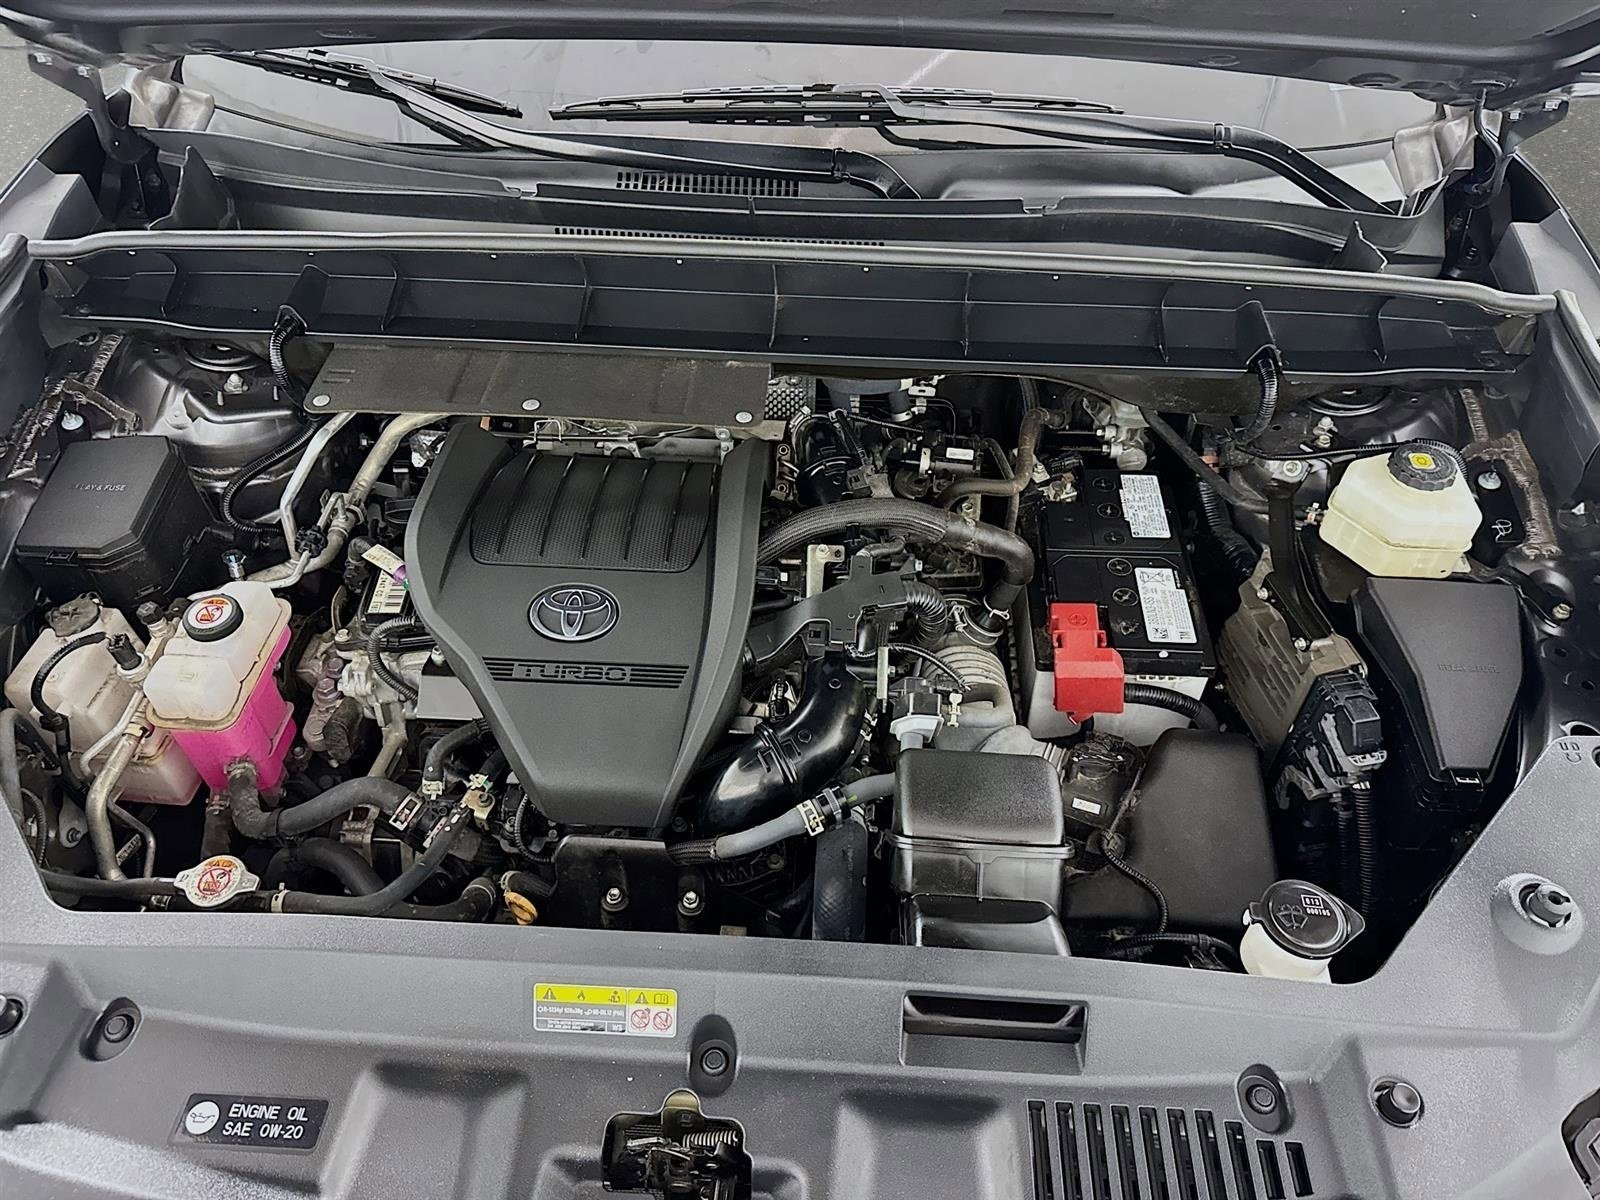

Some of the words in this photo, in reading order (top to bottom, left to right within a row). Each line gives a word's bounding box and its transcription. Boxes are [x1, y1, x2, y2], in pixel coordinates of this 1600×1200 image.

[515, 663, 628, 682] TURBO
[228, 1103, 281, 1120] ENGINE
[287, 1106, 308, 1121] OIL
[222, 1121, 253, 1137] SAE
[259, 1123, 304, 1140] 0W-20
